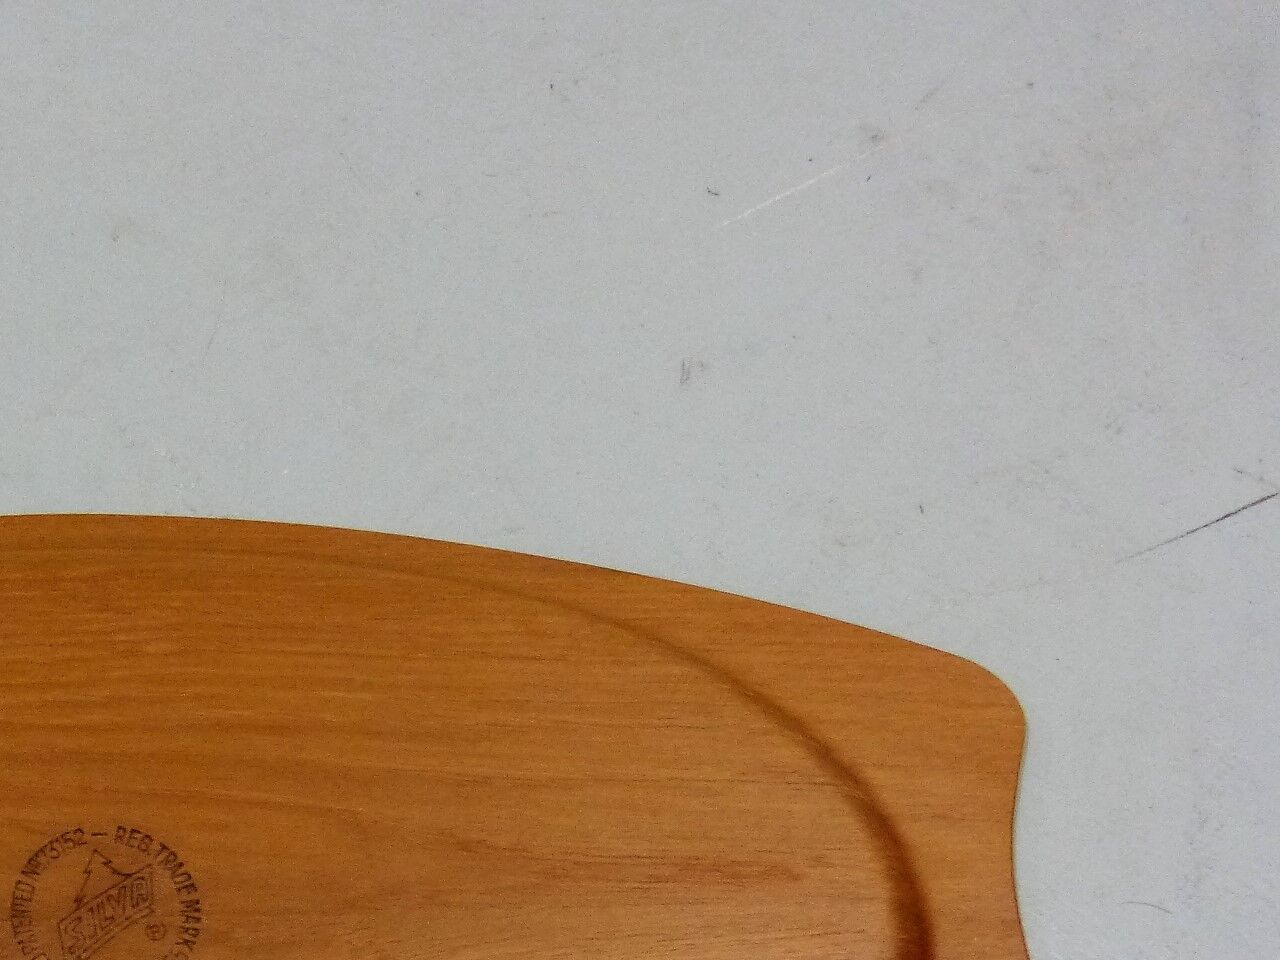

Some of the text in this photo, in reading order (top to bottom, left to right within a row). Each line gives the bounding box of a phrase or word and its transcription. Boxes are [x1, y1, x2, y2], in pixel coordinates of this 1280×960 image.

[154, 842, 198, 895] TRADE
[63, 875, 150, 957] SILVA
[175, 898, 203, 952] MARK
